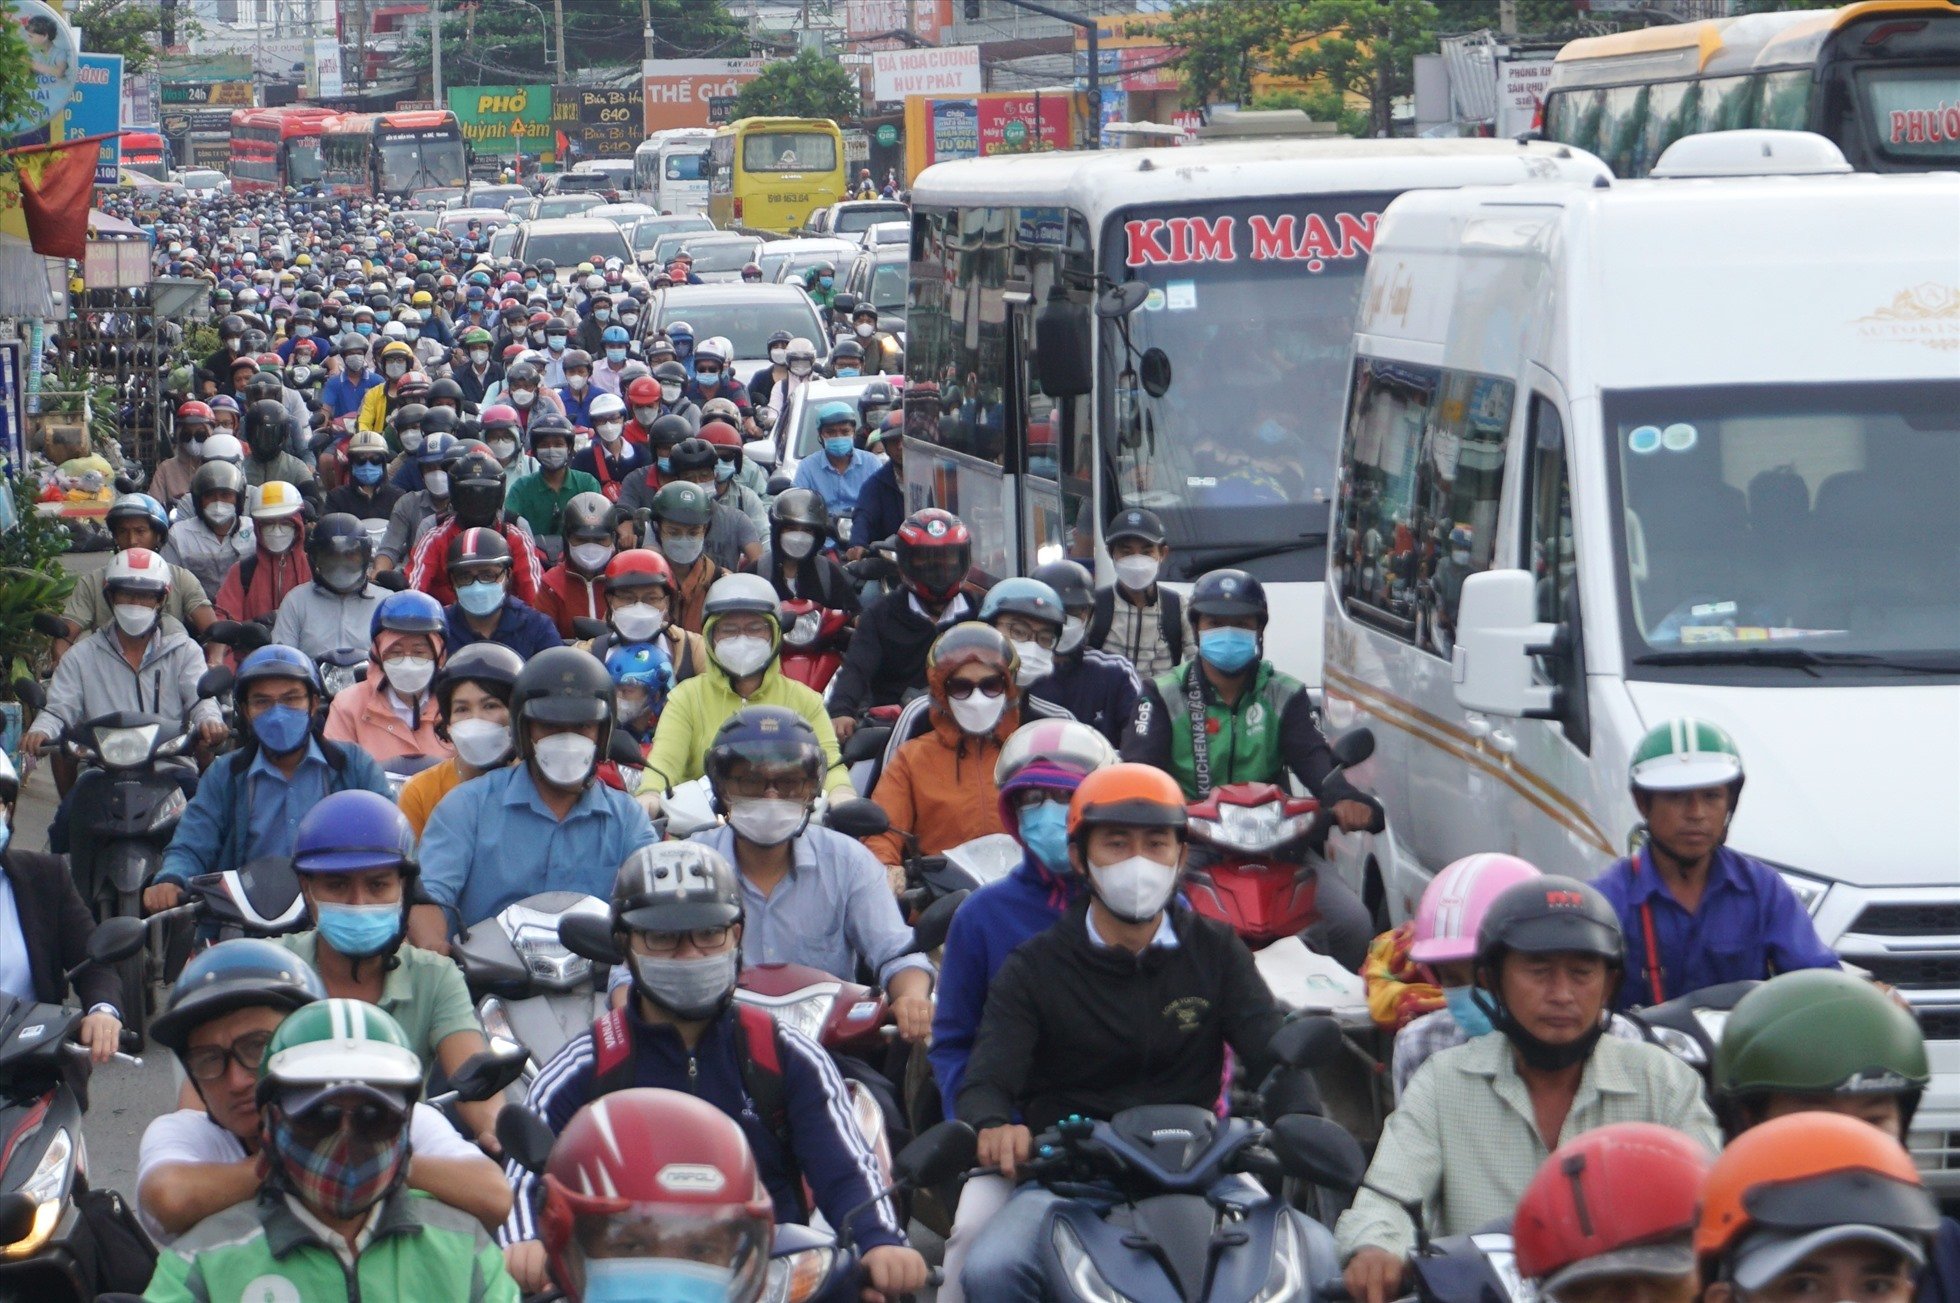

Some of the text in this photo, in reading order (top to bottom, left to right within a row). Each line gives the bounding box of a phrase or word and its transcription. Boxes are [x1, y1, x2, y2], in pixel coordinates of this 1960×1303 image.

[1540, 66, 1551, 77] KH
[648, 77, 743, 103] THẾ GIỚ
[894, 77, 923, 91] HUY
[188, 88, 207, 101] 24h
[477, 87, 527, 114] PHỞ
[628, 89, 644, 105] Hu
[600, 108, 630, 121] 640
[1019, 102, 1036, 114] LG
[95, 167, 117, 179] .100
[1125, 213, 1382, 273] KIM MẠN
[1135, 700, 1153, 736] goje
[1152, 1128, 1193, 1137] HONDA
